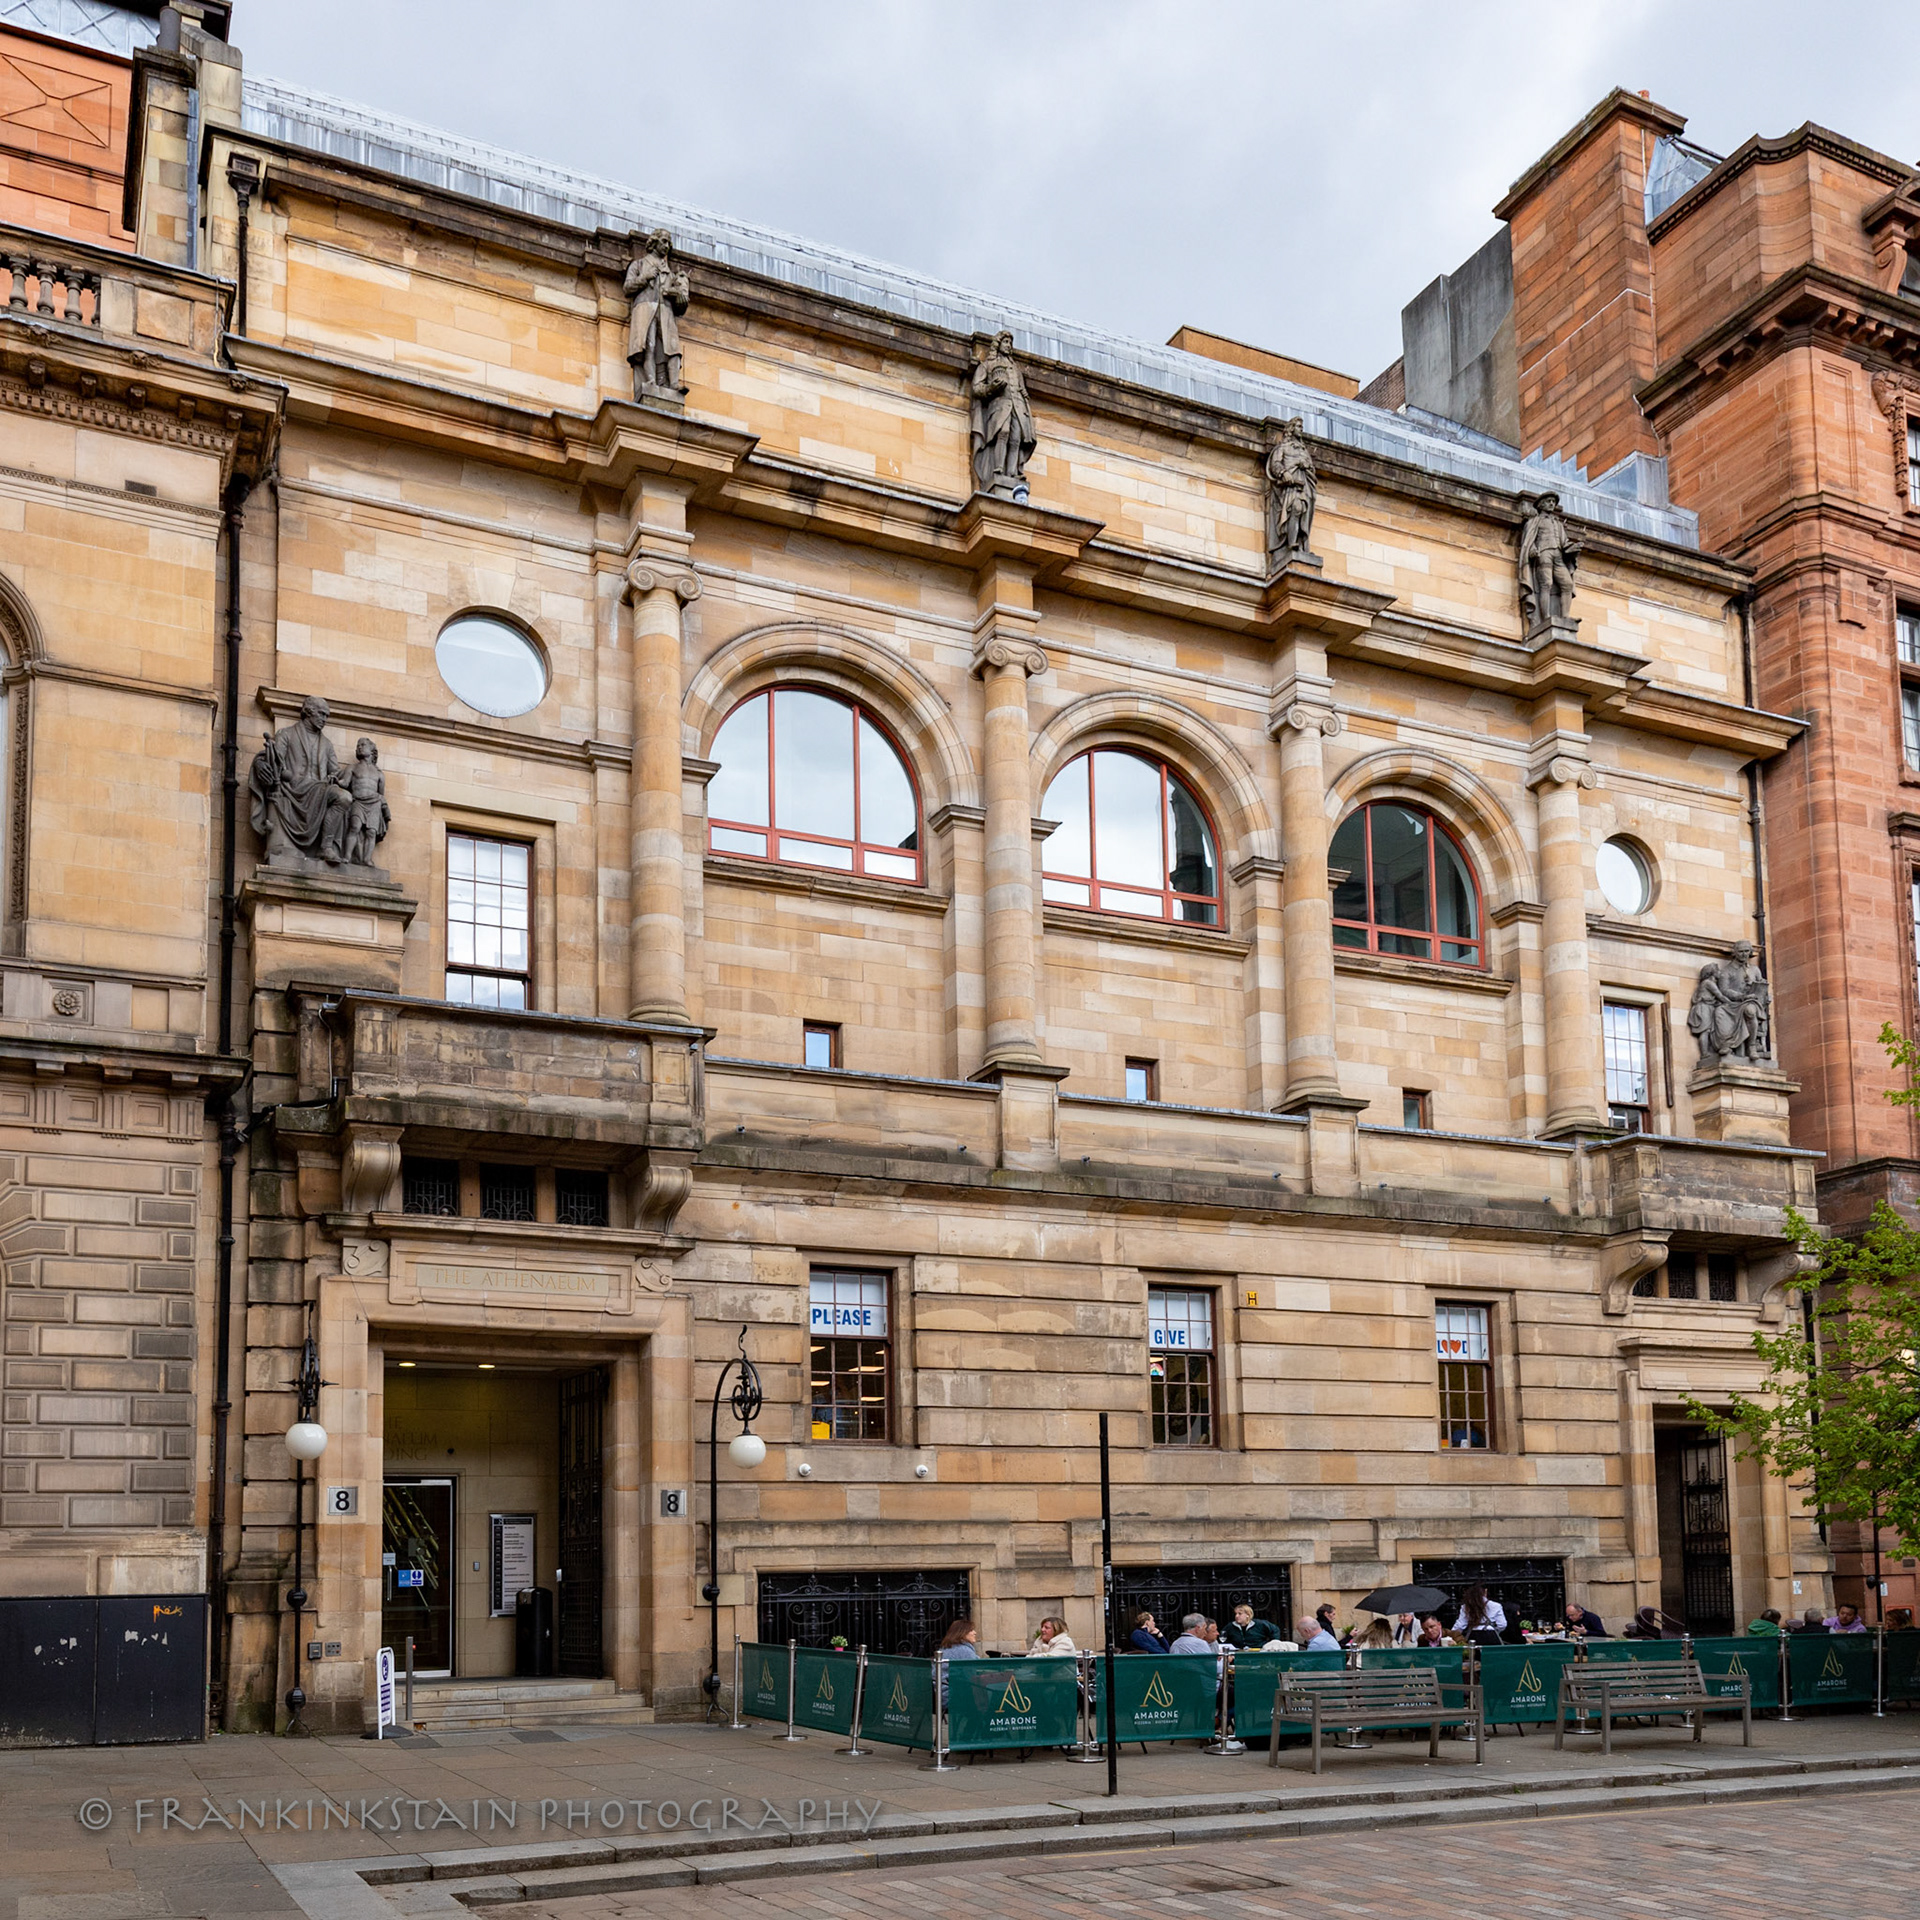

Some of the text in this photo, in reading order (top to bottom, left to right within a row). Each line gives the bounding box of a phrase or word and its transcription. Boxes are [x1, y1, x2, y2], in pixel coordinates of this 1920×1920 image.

[432, 1268, 596, 1292] THE ATHENAEUM
[812, 1308, 871, 1326] PLEASE
[1154, 1329, 1186, 1345] GIVE
[335, 1490, 350, 1511] 8
[667, 1493, 679, 1513] 8
[1720, 1683, 1753, 1692] AMAROE
[1817, 1679, 1848, 1687] AMARONE
[1510, 1694, 1546, 1703] AMARONE
[812, 1702, 836, 1712] AMARONE
[883, 1713, 911, 1724] AMARONE
[1134, 1710, 1179, 1720] AMARONE
[990, 1716, 1037, 1726] AMARONE
